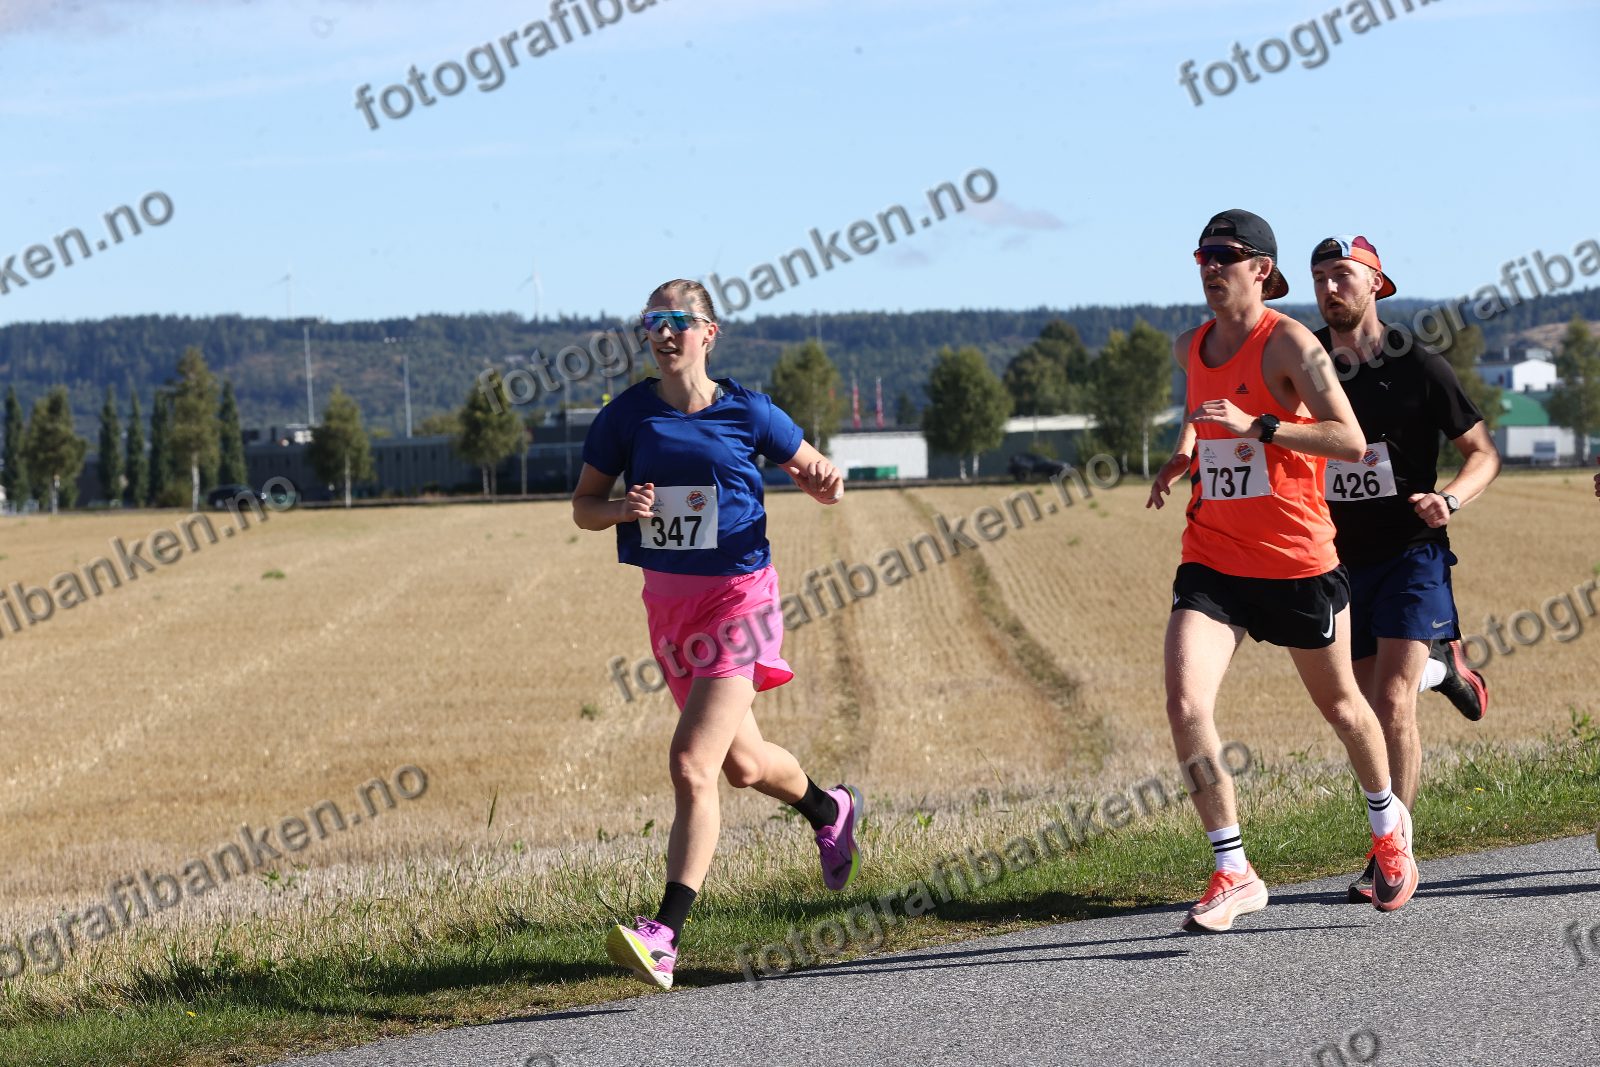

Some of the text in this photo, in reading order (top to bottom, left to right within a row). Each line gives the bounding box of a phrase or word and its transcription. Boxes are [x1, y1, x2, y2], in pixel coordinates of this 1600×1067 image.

[1207, 466, 1251, 497] 737
[1333, 471, 1380, 498] 426
[651, 516, 702, 547] 347
